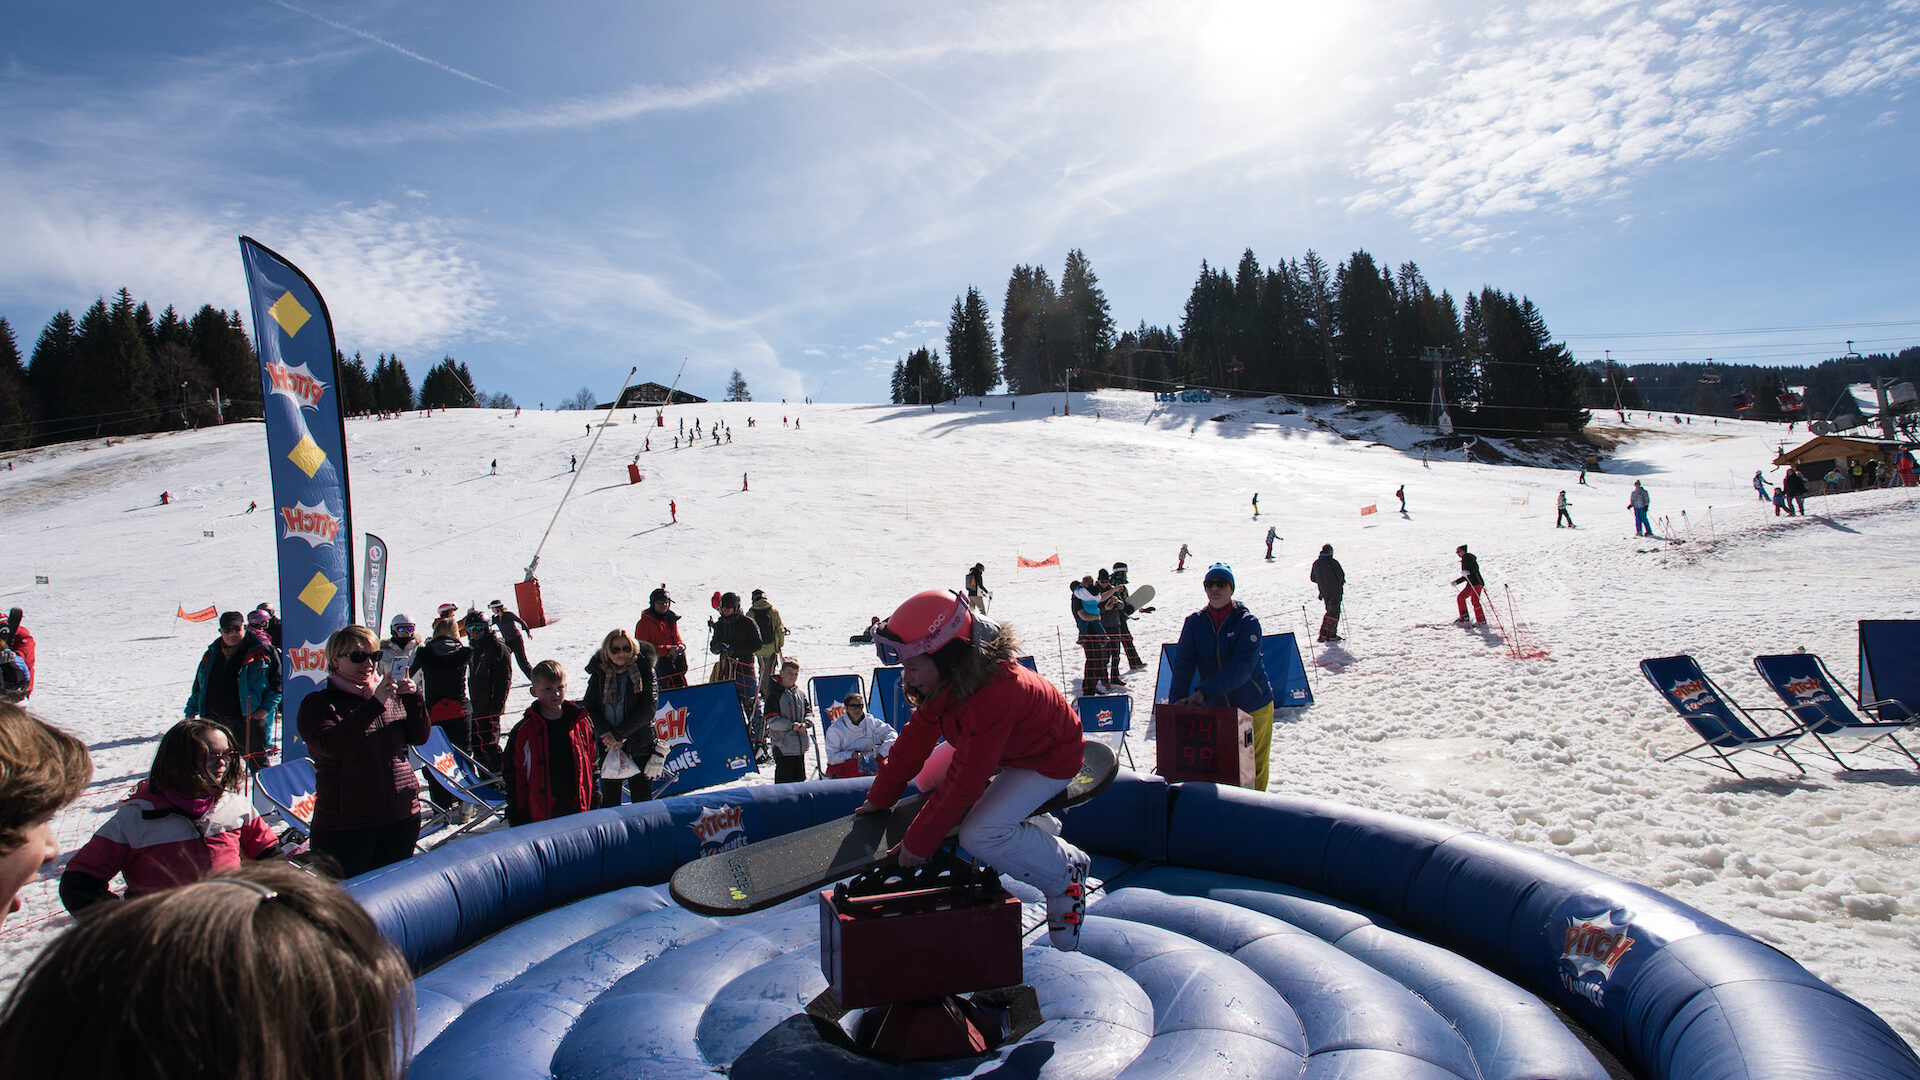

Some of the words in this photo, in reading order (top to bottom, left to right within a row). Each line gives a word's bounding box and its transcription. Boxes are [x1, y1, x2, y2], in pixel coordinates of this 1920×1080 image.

[1154, 389, 1177, 403] Les
[1181, 389, 1212, 403] Gets
[1183, 746, 1213, 768] 99
[693, 806, 742, 842] PiTCH
[1564, 921, 1636, 969] PiTCH
